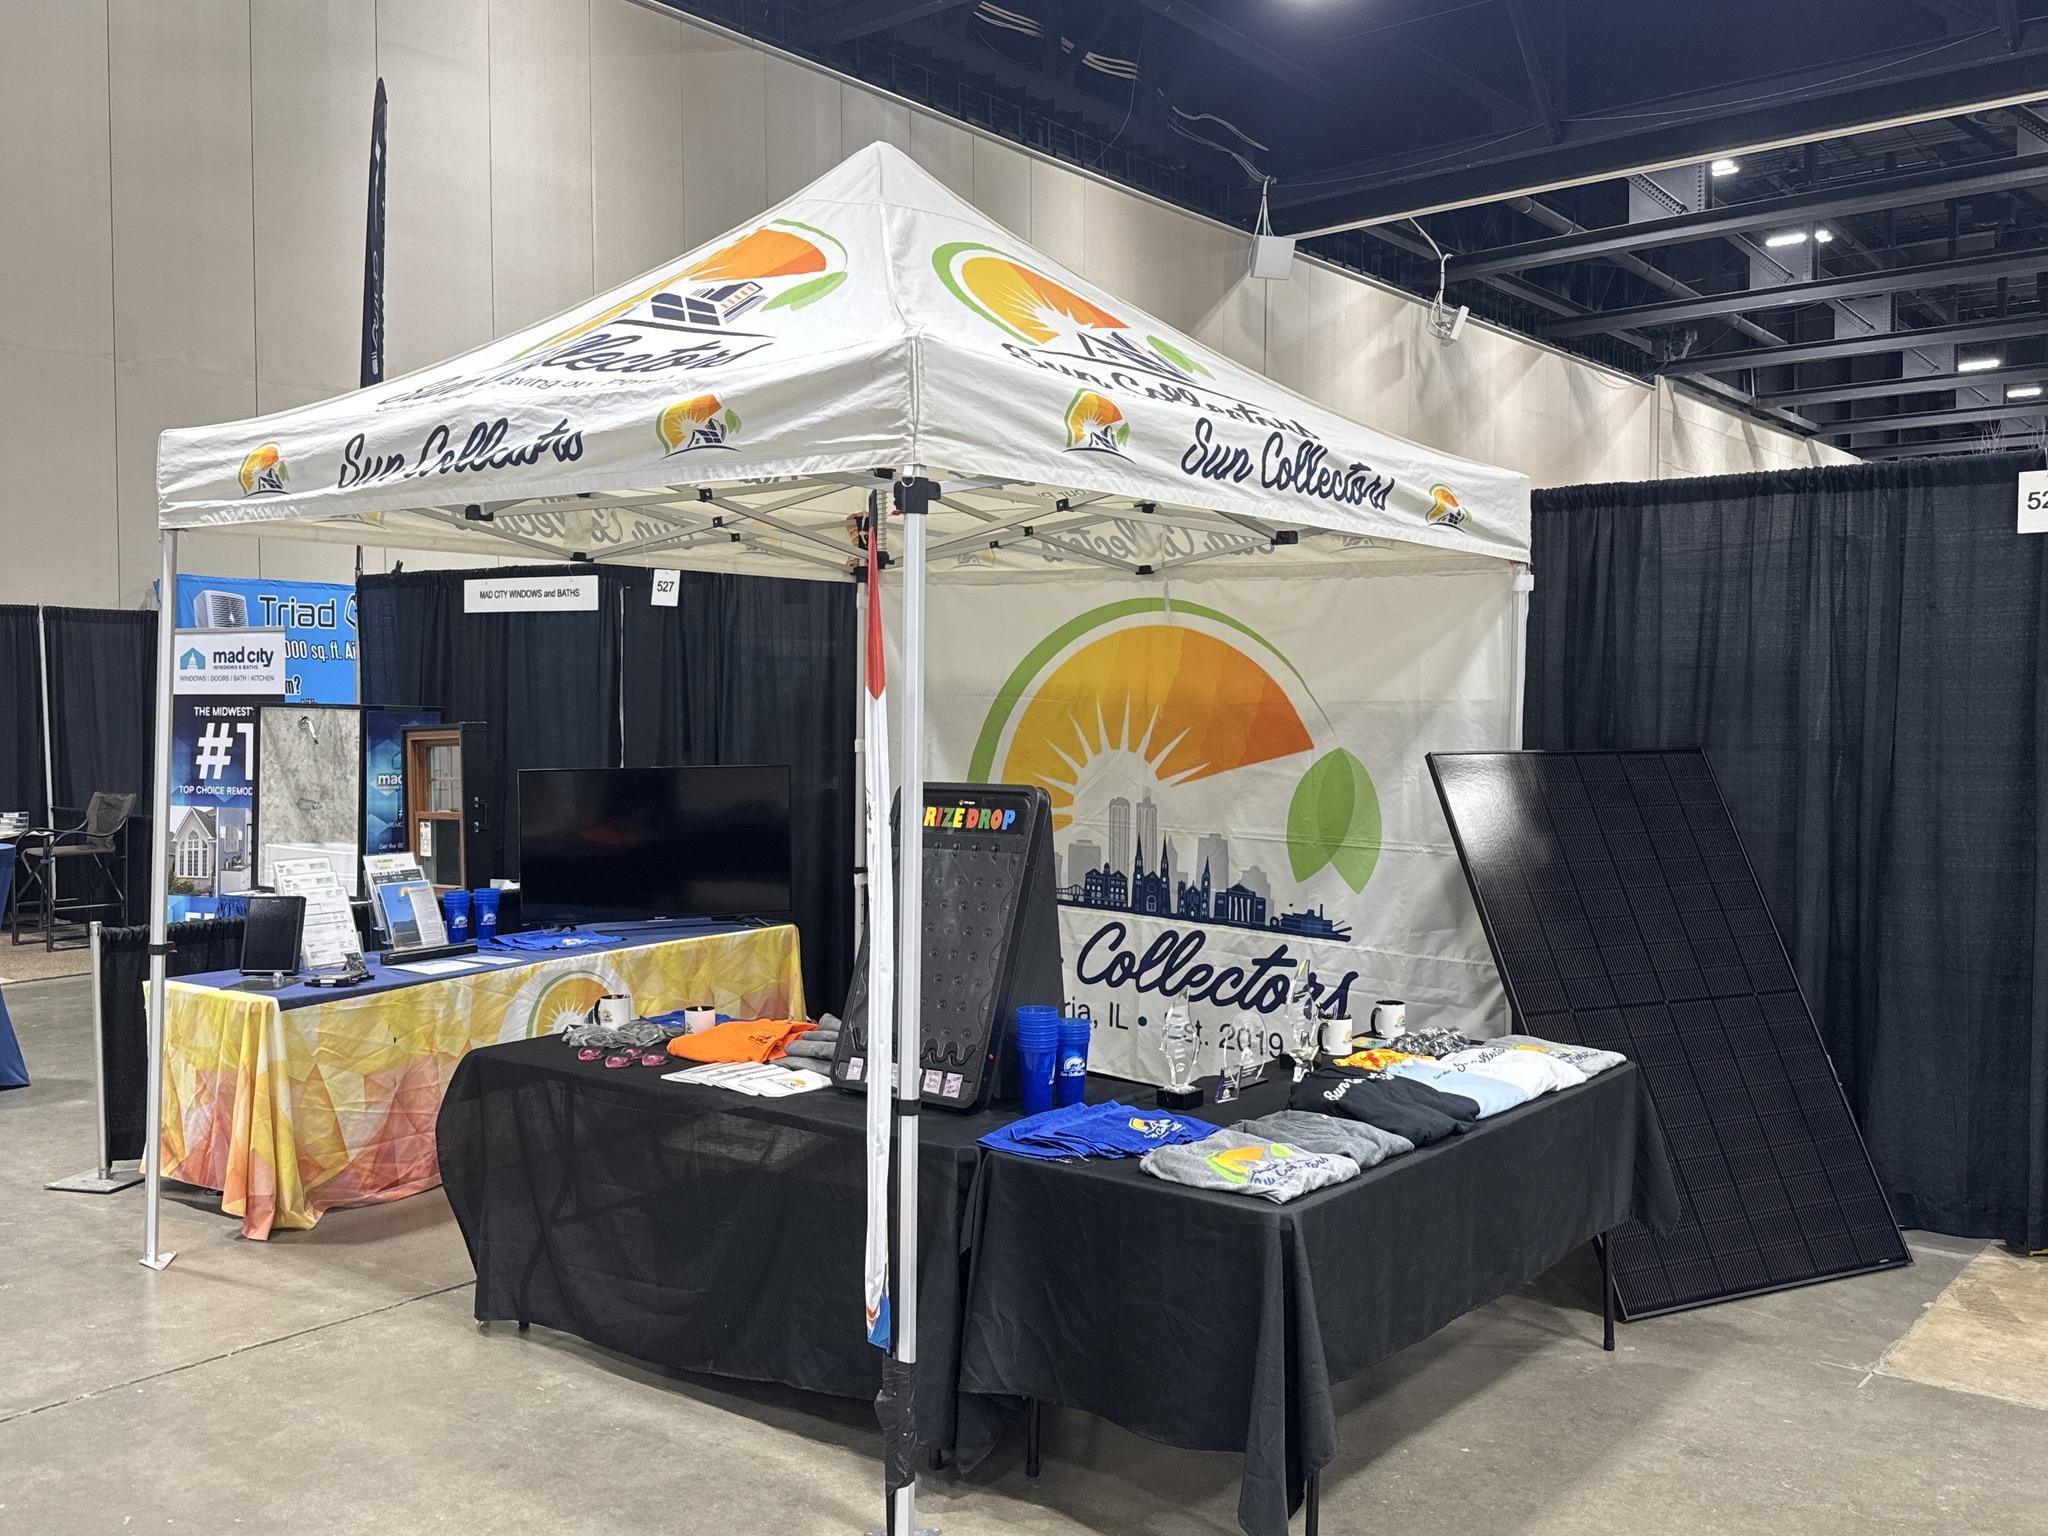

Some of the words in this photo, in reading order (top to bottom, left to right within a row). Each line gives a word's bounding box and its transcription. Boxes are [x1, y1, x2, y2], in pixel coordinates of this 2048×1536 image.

[1181, 417, 1253, 483] Sun
[1261, 431, 1395, 511] Collectors
[480, 590, 493, 599] MAD
[494, 590, 508, 599] CITY
[509, 589, 543, 599] WINDOWS
[543, 589, 556, 598] and
[557, 588, 580, 598] BATHS
[657, 580, 674, 593] 527
[258, 595, 336, 629] Triad
[213, 646, 245, 664] mad
[246, 647, 274, 668] city
[311, 644, 328, 662] sq.
[330, 641, 343, 660] ft.
[193, 706, 211, 716] THE
[195, 722, 254, 781] #1
[179, 785, 195, 795] TOP
[195, 785, 225, 795] CHOICE
[923, 806, 965, 827] RIZE
[966, 808, 1015, 831] DROP
[1109, 1002, 1129, 1030] IL
